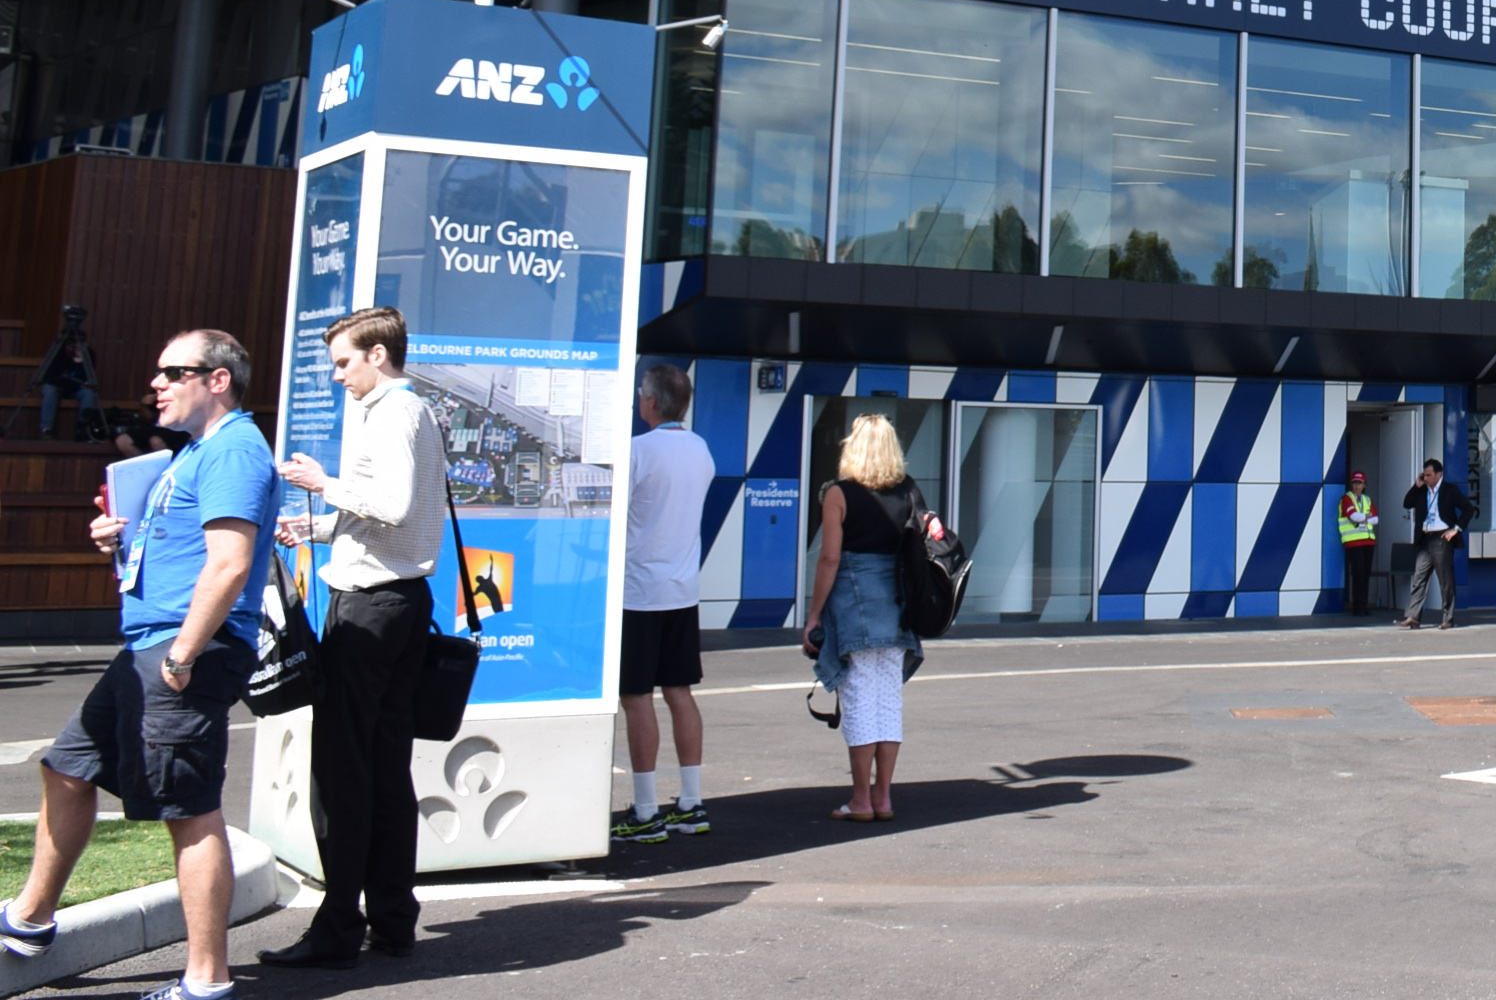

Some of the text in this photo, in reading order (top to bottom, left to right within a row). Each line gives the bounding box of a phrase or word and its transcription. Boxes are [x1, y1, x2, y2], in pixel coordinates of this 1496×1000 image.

[435, 58, 545, 106] ANZ
[311, 224, 329, 248] Your
[430, 215, 579, 250] Your Game.
[440, 246, 566, 284] Your Way.
[407, 343, 598, 361] ELBOURNE PARK GROUNDS MAP
[745, 487, 799, 498] Presidents
[750, 497, 793, 507] Reserve
[500, 634, 534, 650] open
[285, 650, 307, 668] oen
